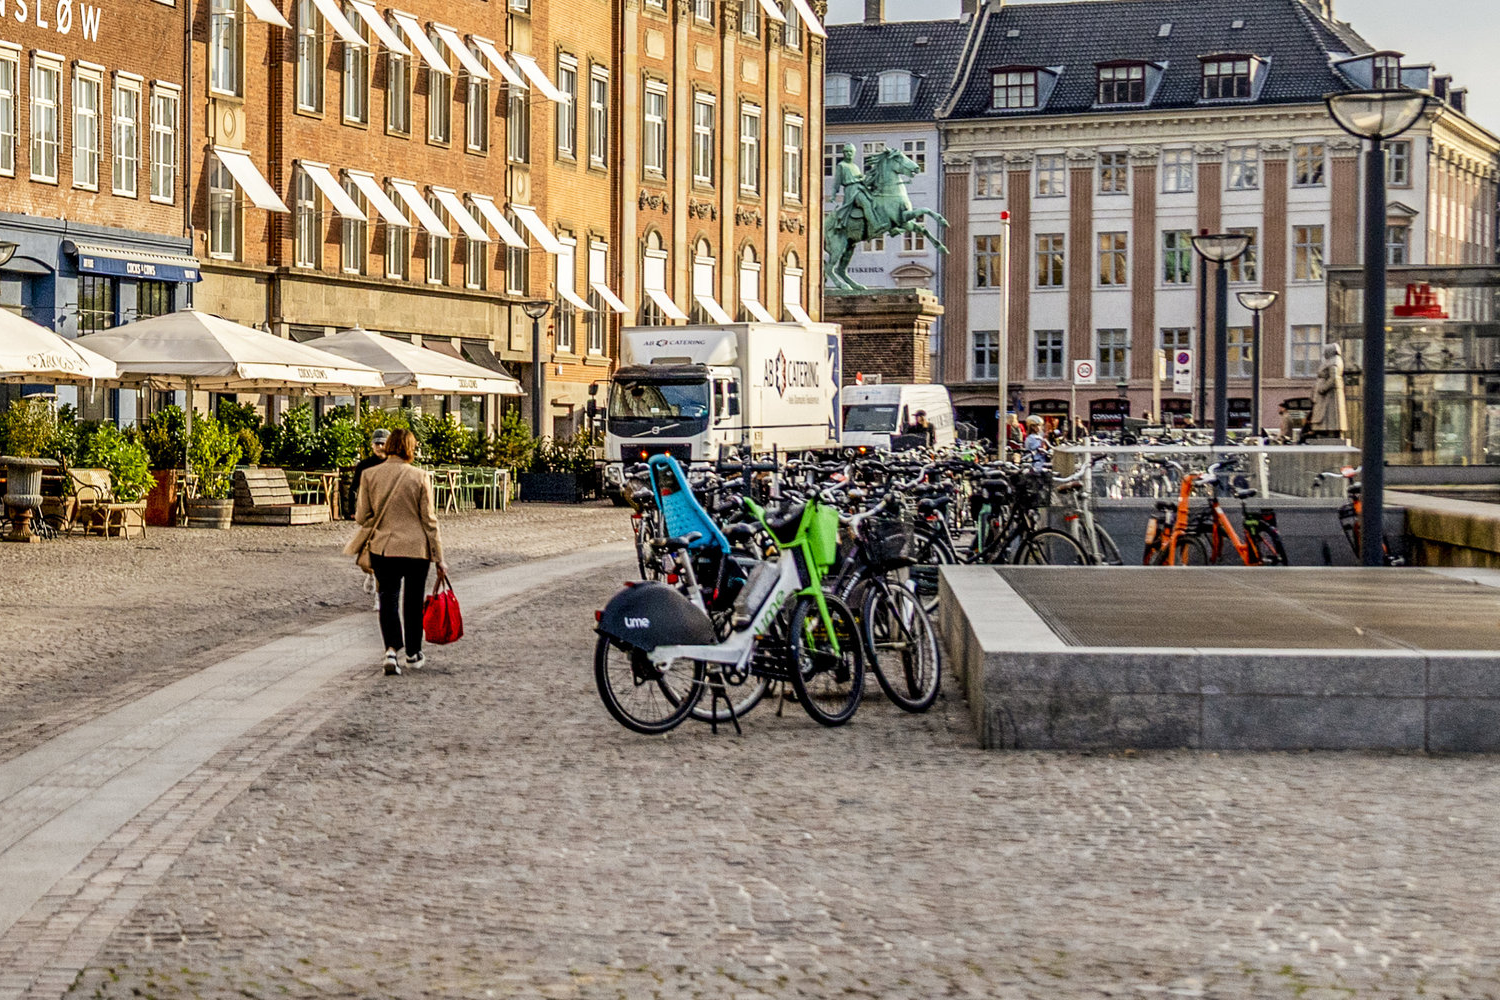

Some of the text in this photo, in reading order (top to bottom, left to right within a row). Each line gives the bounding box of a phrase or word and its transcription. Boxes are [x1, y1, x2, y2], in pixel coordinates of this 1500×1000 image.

[763, 358, 819, 388] AB CATERING
[1080, 367, 1090, 375] 30
